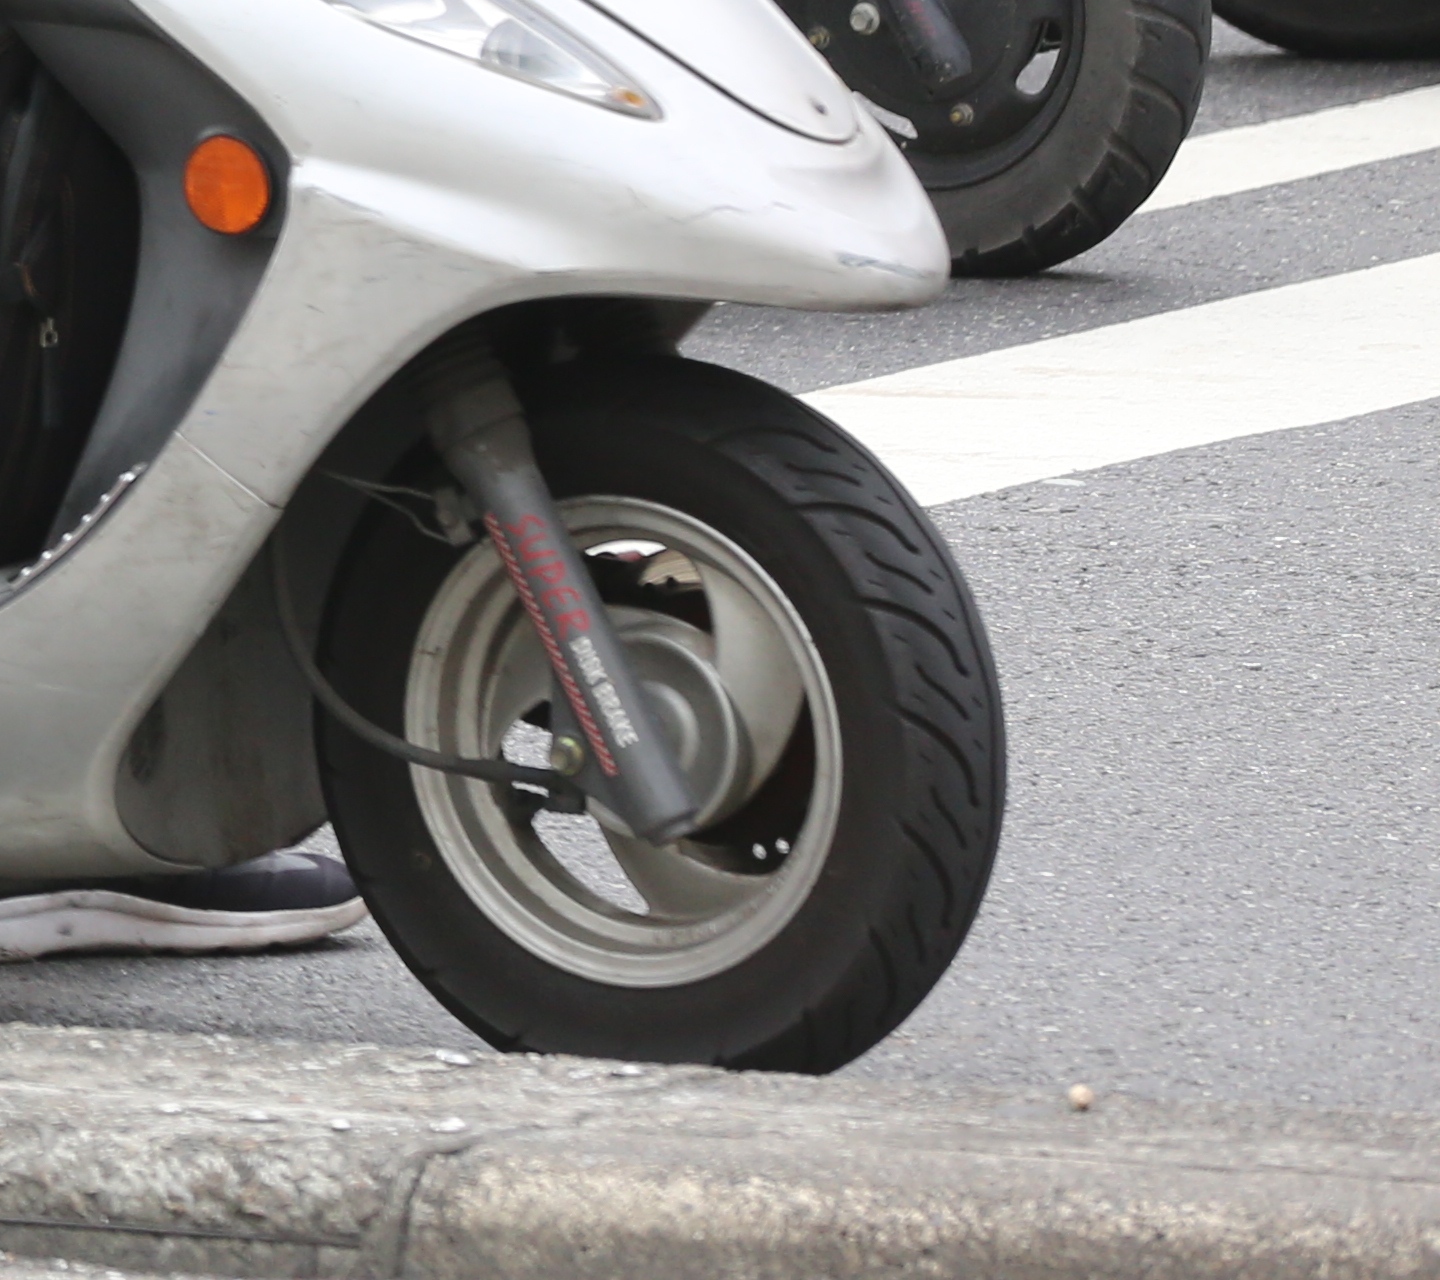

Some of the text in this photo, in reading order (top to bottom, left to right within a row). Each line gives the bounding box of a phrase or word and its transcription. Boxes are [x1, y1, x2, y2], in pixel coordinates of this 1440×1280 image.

[505, 513, 640, 748] SUPER DISK BRAKE
